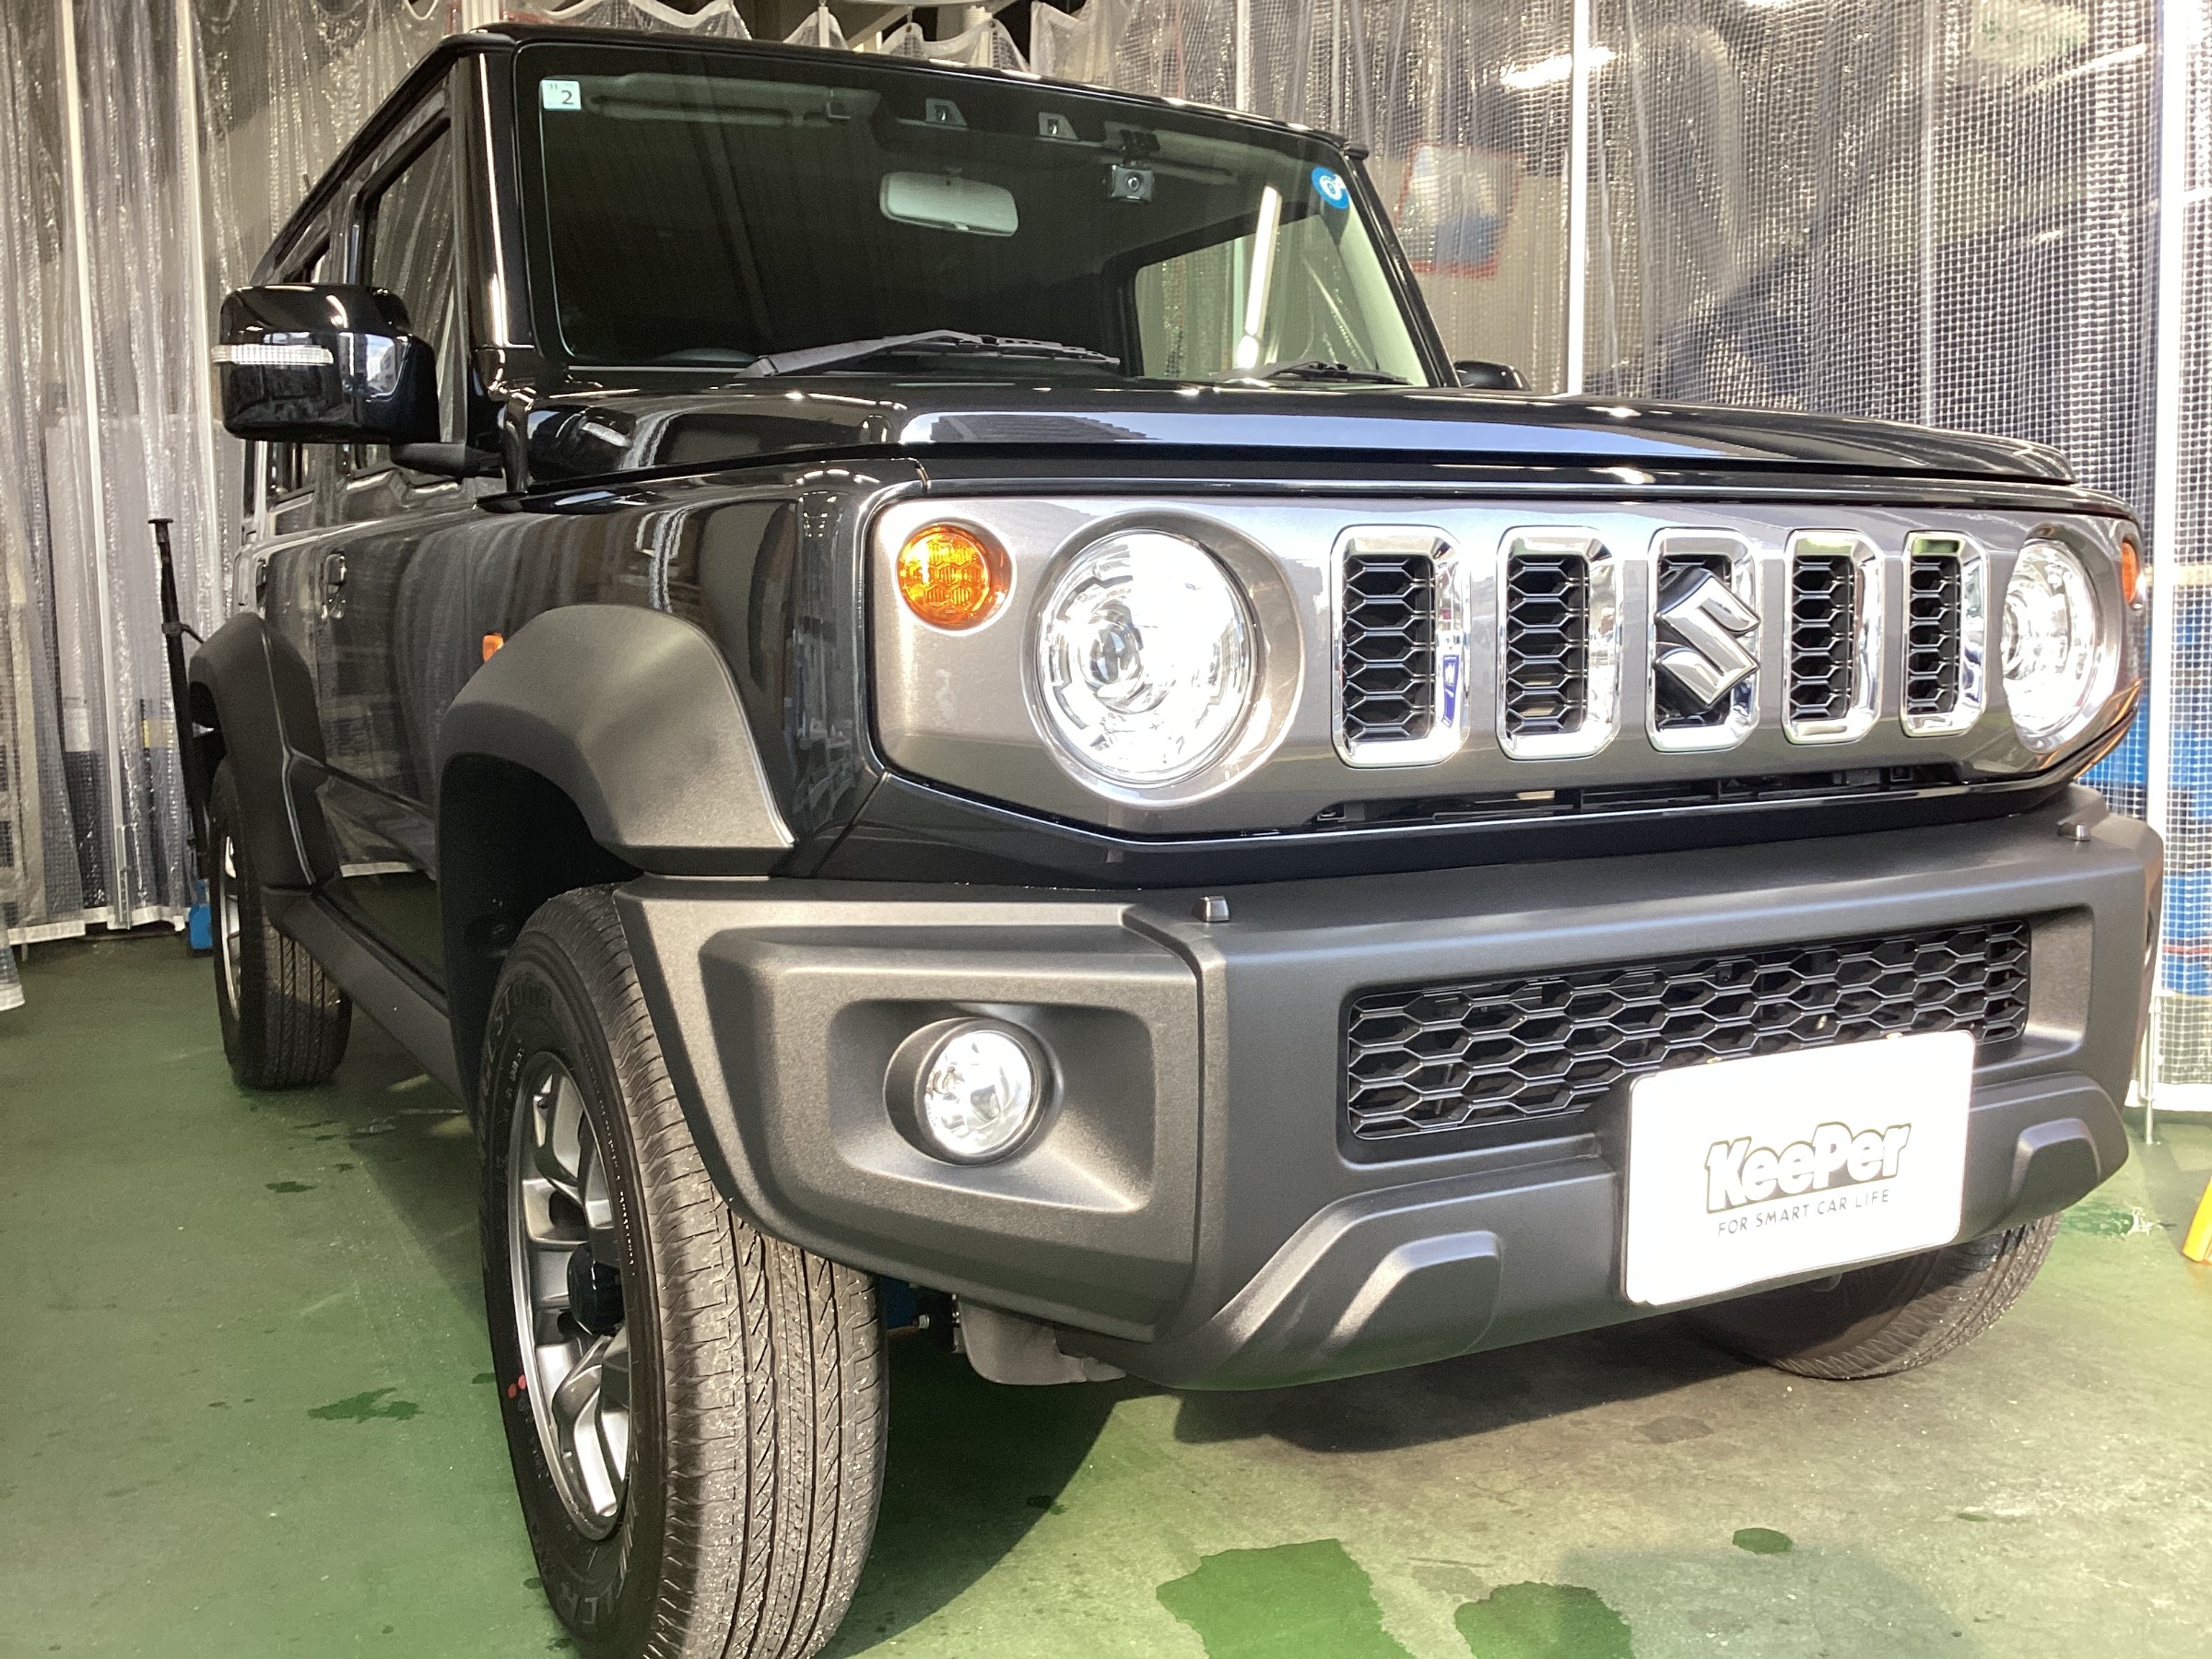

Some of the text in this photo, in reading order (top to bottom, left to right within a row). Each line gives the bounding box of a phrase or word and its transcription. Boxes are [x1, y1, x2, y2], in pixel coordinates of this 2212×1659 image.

[561, 90, 574, 104] 2
[1705, 1122, 1911, 1214] KeePer
[1717, 1189, 1890, 1237] FOR SMART CAR LIFE
